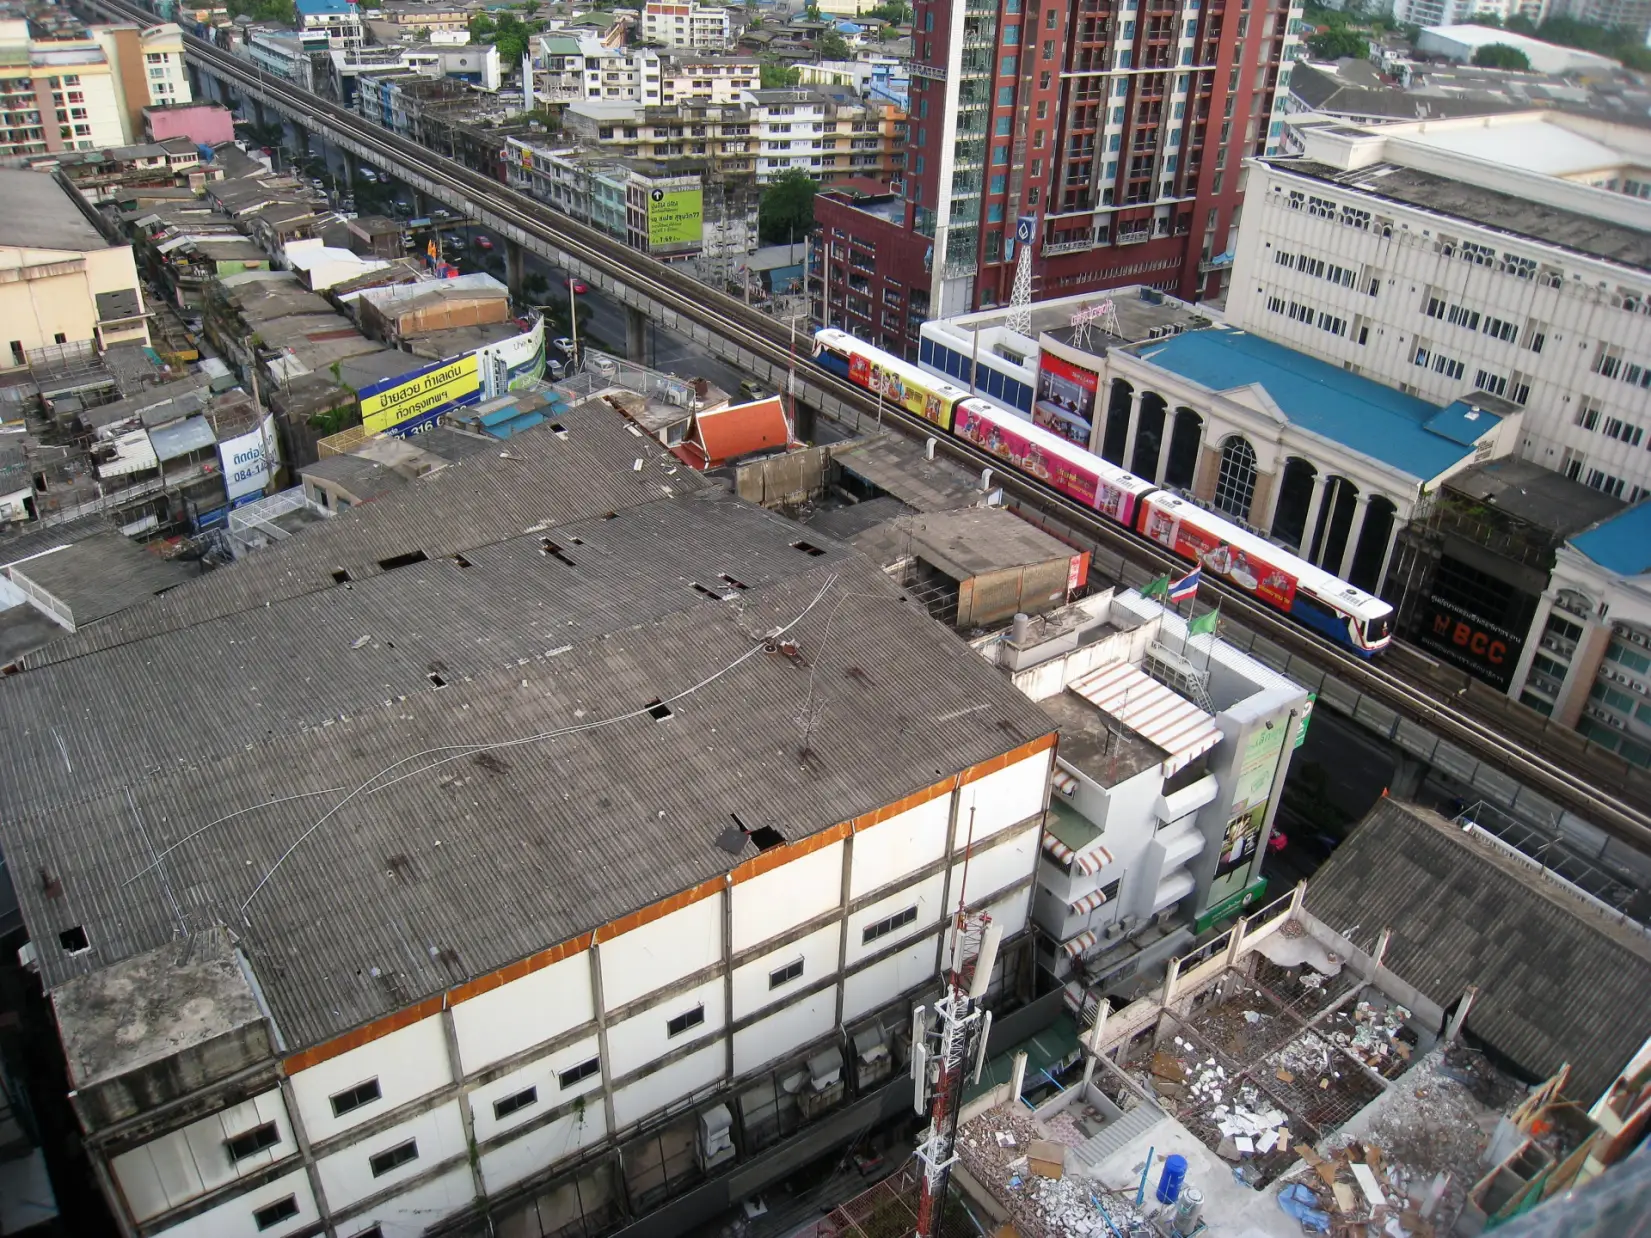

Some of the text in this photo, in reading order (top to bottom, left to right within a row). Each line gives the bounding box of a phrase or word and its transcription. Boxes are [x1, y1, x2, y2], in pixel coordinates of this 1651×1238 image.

[380, 366, 462, 408] ป้ายสวย ทำเลเด่น
[396, 390, 449, 420] ทั่วกรุงเทพฯ
[1452, 621, 1507, 664] BCC
